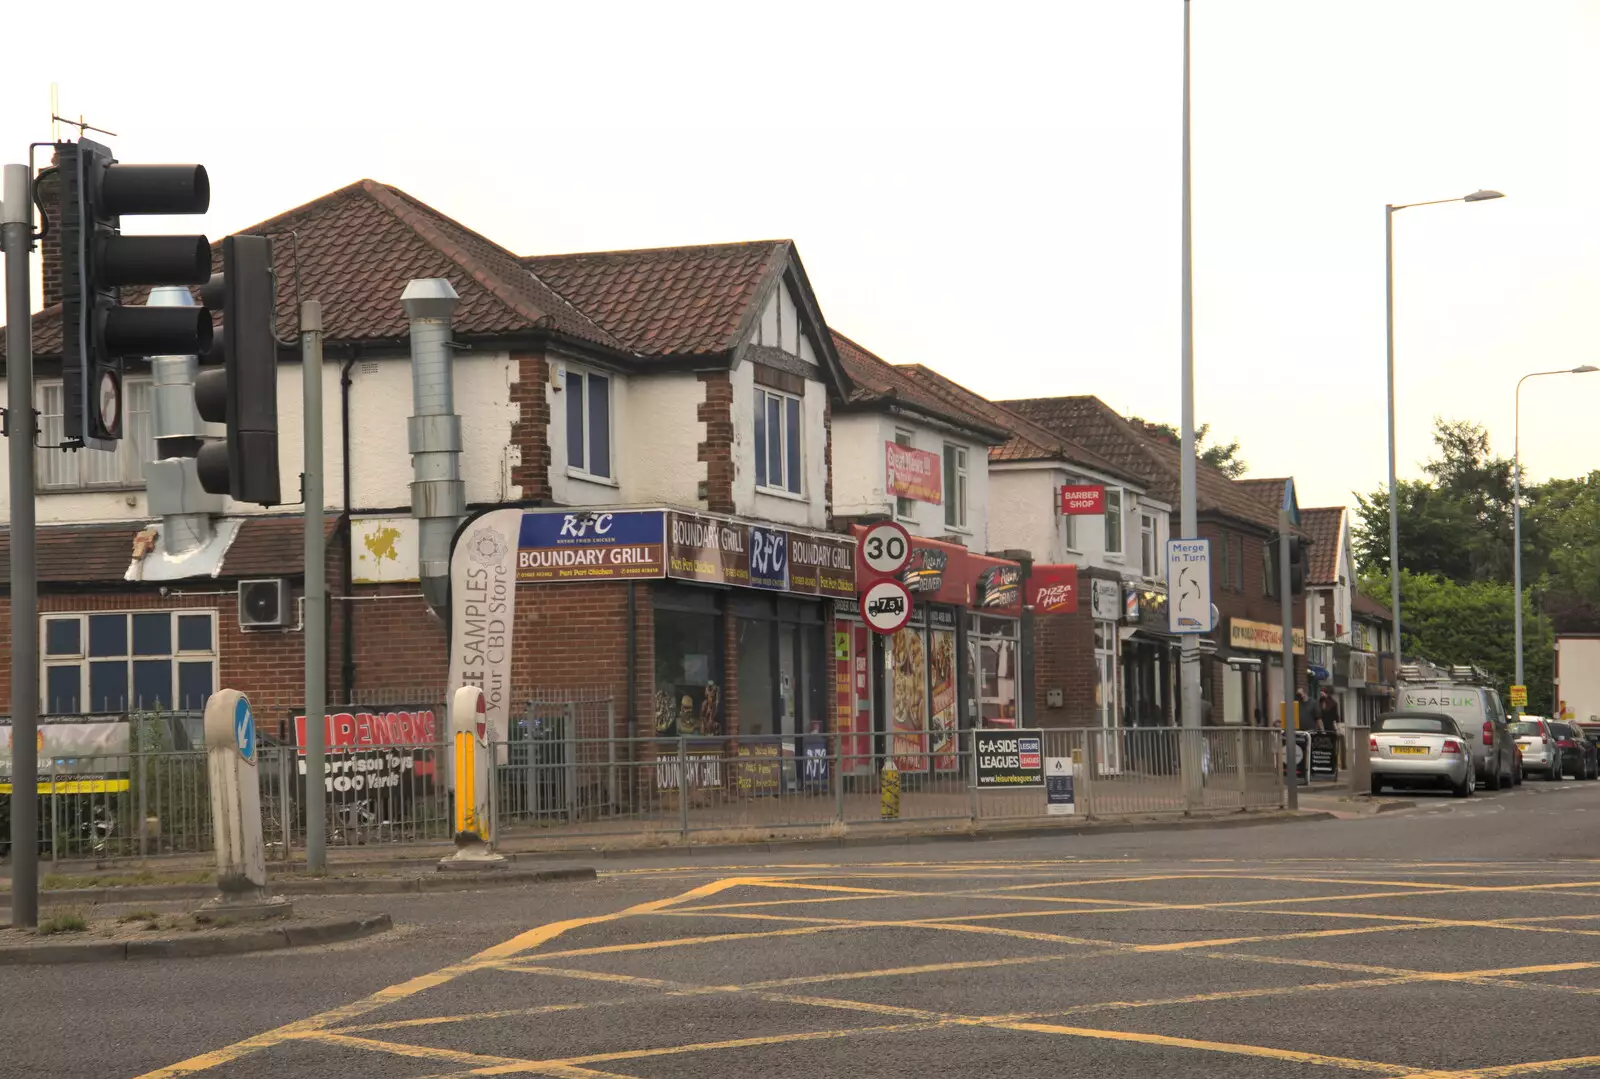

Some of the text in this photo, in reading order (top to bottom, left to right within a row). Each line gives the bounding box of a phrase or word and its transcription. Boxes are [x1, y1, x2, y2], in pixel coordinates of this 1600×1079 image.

[1065, 491, 1099, 500] BARBER
[1070, 500, 1094, 508] SHOP
[560, 513, 613, 536] RFC
[673, 520, 744, 552] BOUNDARY GRILL
[520, 547, 653, 567] BOUNDARY GRILL
[752, 531, 784, 574] RFC
[792, 541, 851, 570] BOUNDARY GRILL
[867, 536, 905, 560] 30
[1173, 543, 1205, 553] Merge
[1183, 553, 1206, 562] Turn
[488, 565, 508, 614] Store
[1036, 584, 1072, 604] Pizza
[464, 567, 488, 666] SAMPLES
[487, 619, 506, 664] CBD
[294, 710, 436, 756] IREWORKS
[979, 740, 1017, 752] 6-A-SIDE
[386, 753, 413, 773] Toys
[656, 755, 699, 788] BOUNARY
[806, 748, 827, 777] RFC
[980, 756, 1018, 768] LEAGUES
[367, 772, 400, 789] Yards
[981, 774, 1041, 784] www.leisureleagues.net
